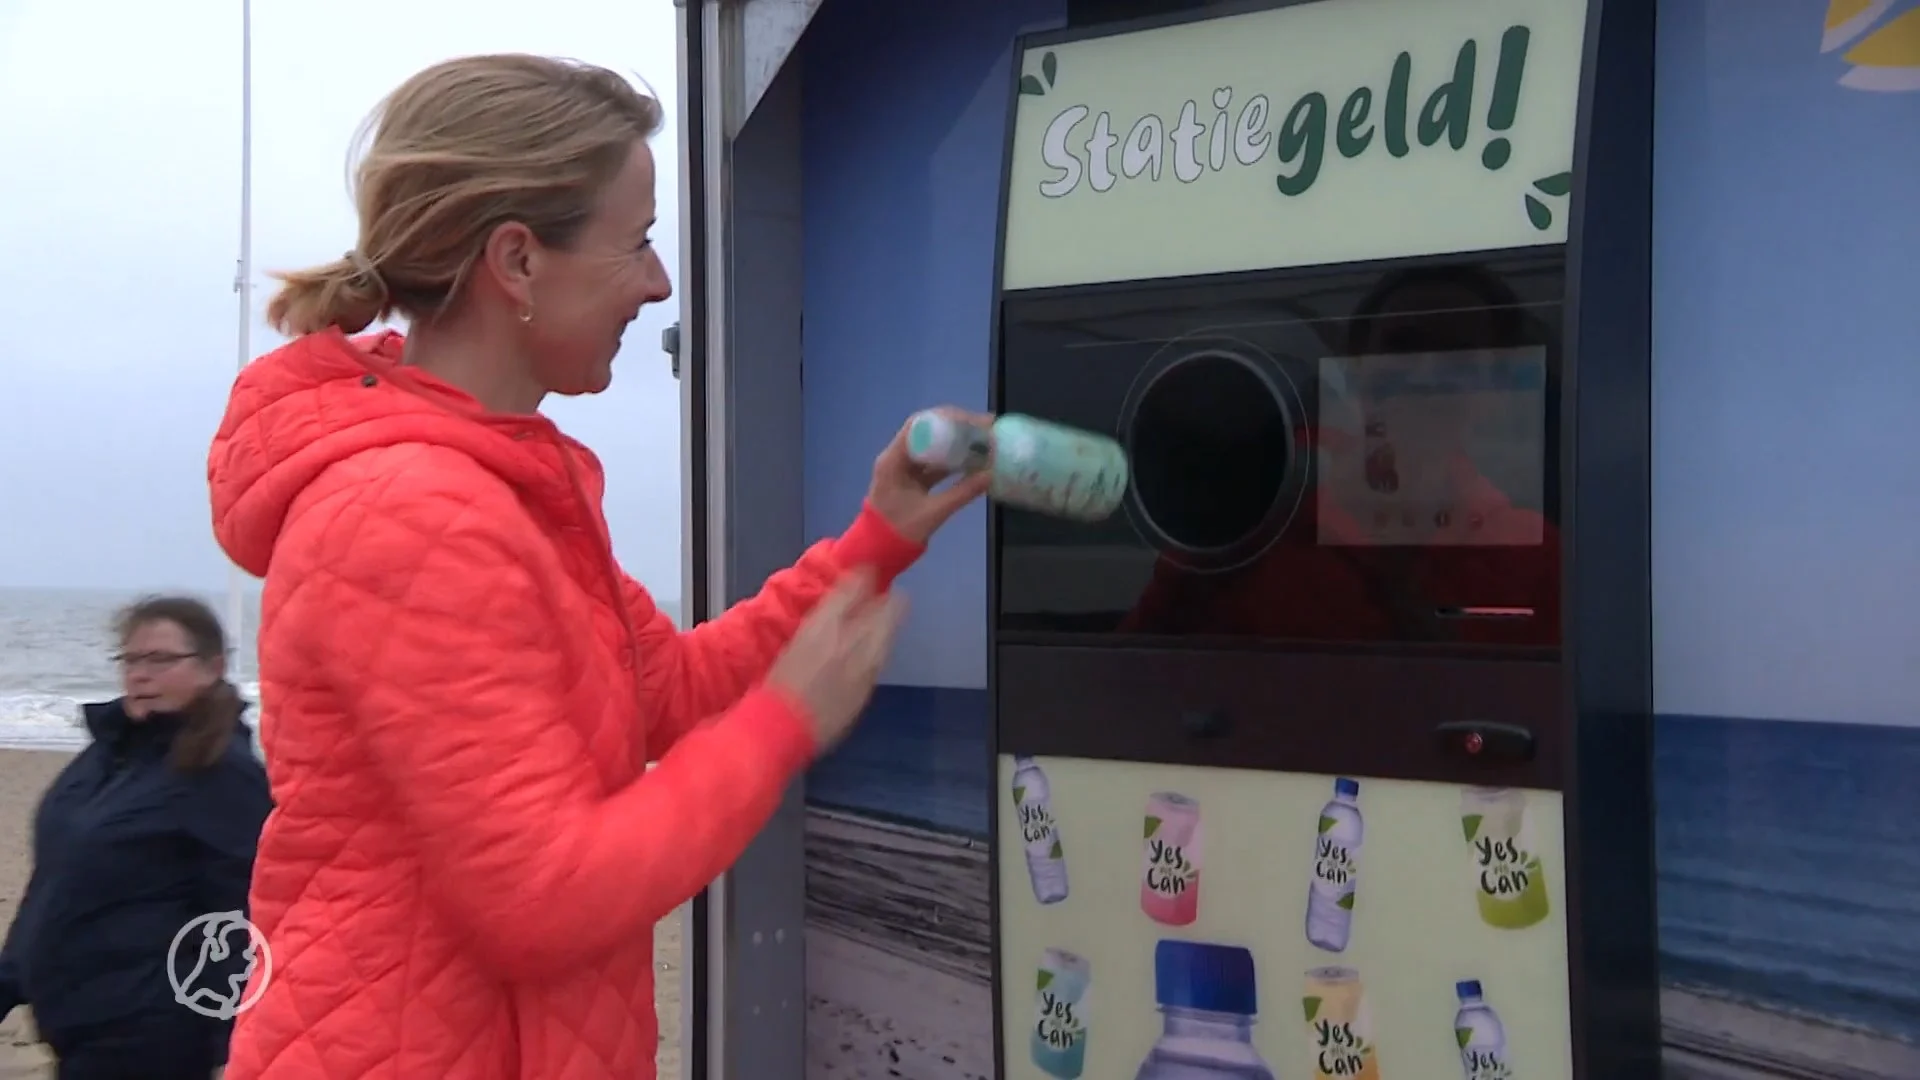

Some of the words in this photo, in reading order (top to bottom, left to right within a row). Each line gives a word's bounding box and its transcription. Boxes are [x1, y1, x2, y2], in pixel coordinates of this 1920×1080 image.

[1039, 24, 1531, 198] Statiegeld!
[1150, 839, 1183, 869] Yes
[1320, 838, 1347, 864] Yes
[1475, 836, 1518, 866] Yes
[1147, 868, 1185, 894] Can
[1316, 861, 1347, 884] Can
[1480, 870, 1528, 895] Can
[1041, 991, 1072, 1024] Yes
[1038, 1019, 1074, 1048] Can
[1314, 1018, 1354, 1047] Yes
[1318, 1050, 1363, 1075] Can
